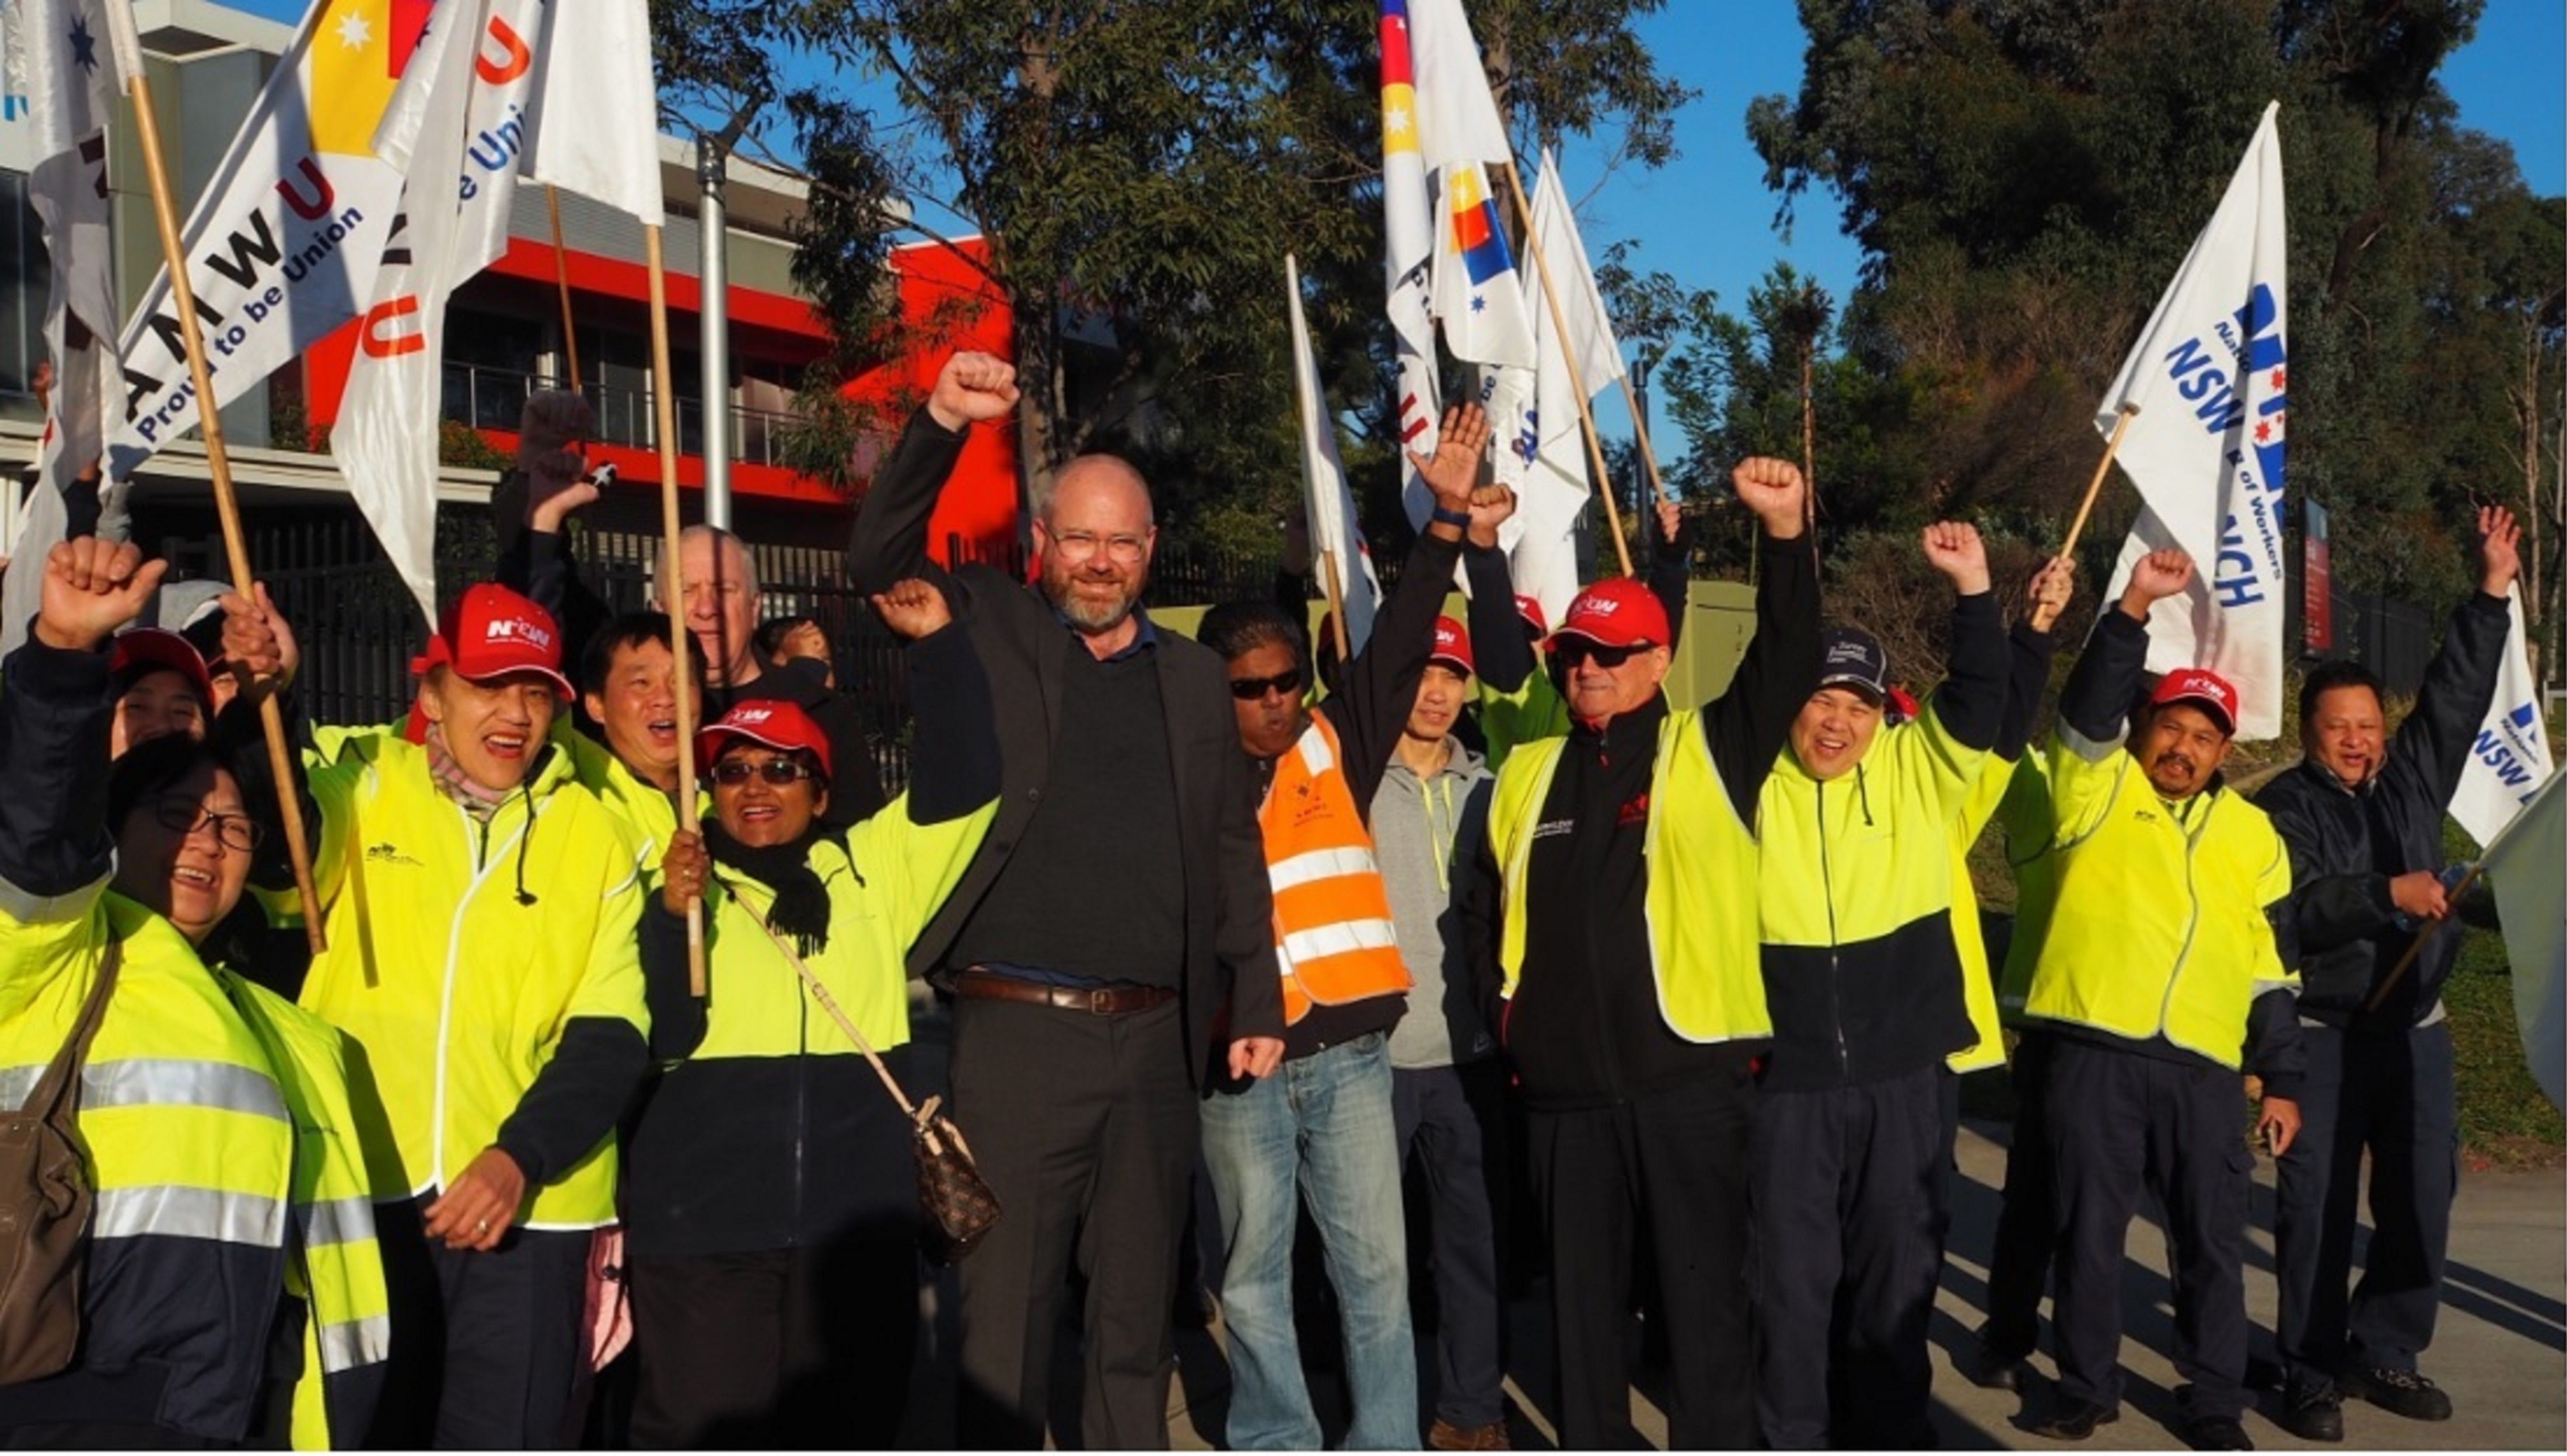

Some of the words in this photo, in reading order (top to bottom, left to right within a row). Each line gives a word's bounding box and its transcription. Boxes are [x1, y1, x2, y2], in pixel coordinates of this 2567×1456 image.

[214, 326, 246, 356] to
[243, 286, 283, 323] be
[281, 207, 363, 282] Union
[2164, 337, 2245, 435] NSW
[2250, 497, 2281, 580] Workers
[2475, 730, 2532, 787] NSW
